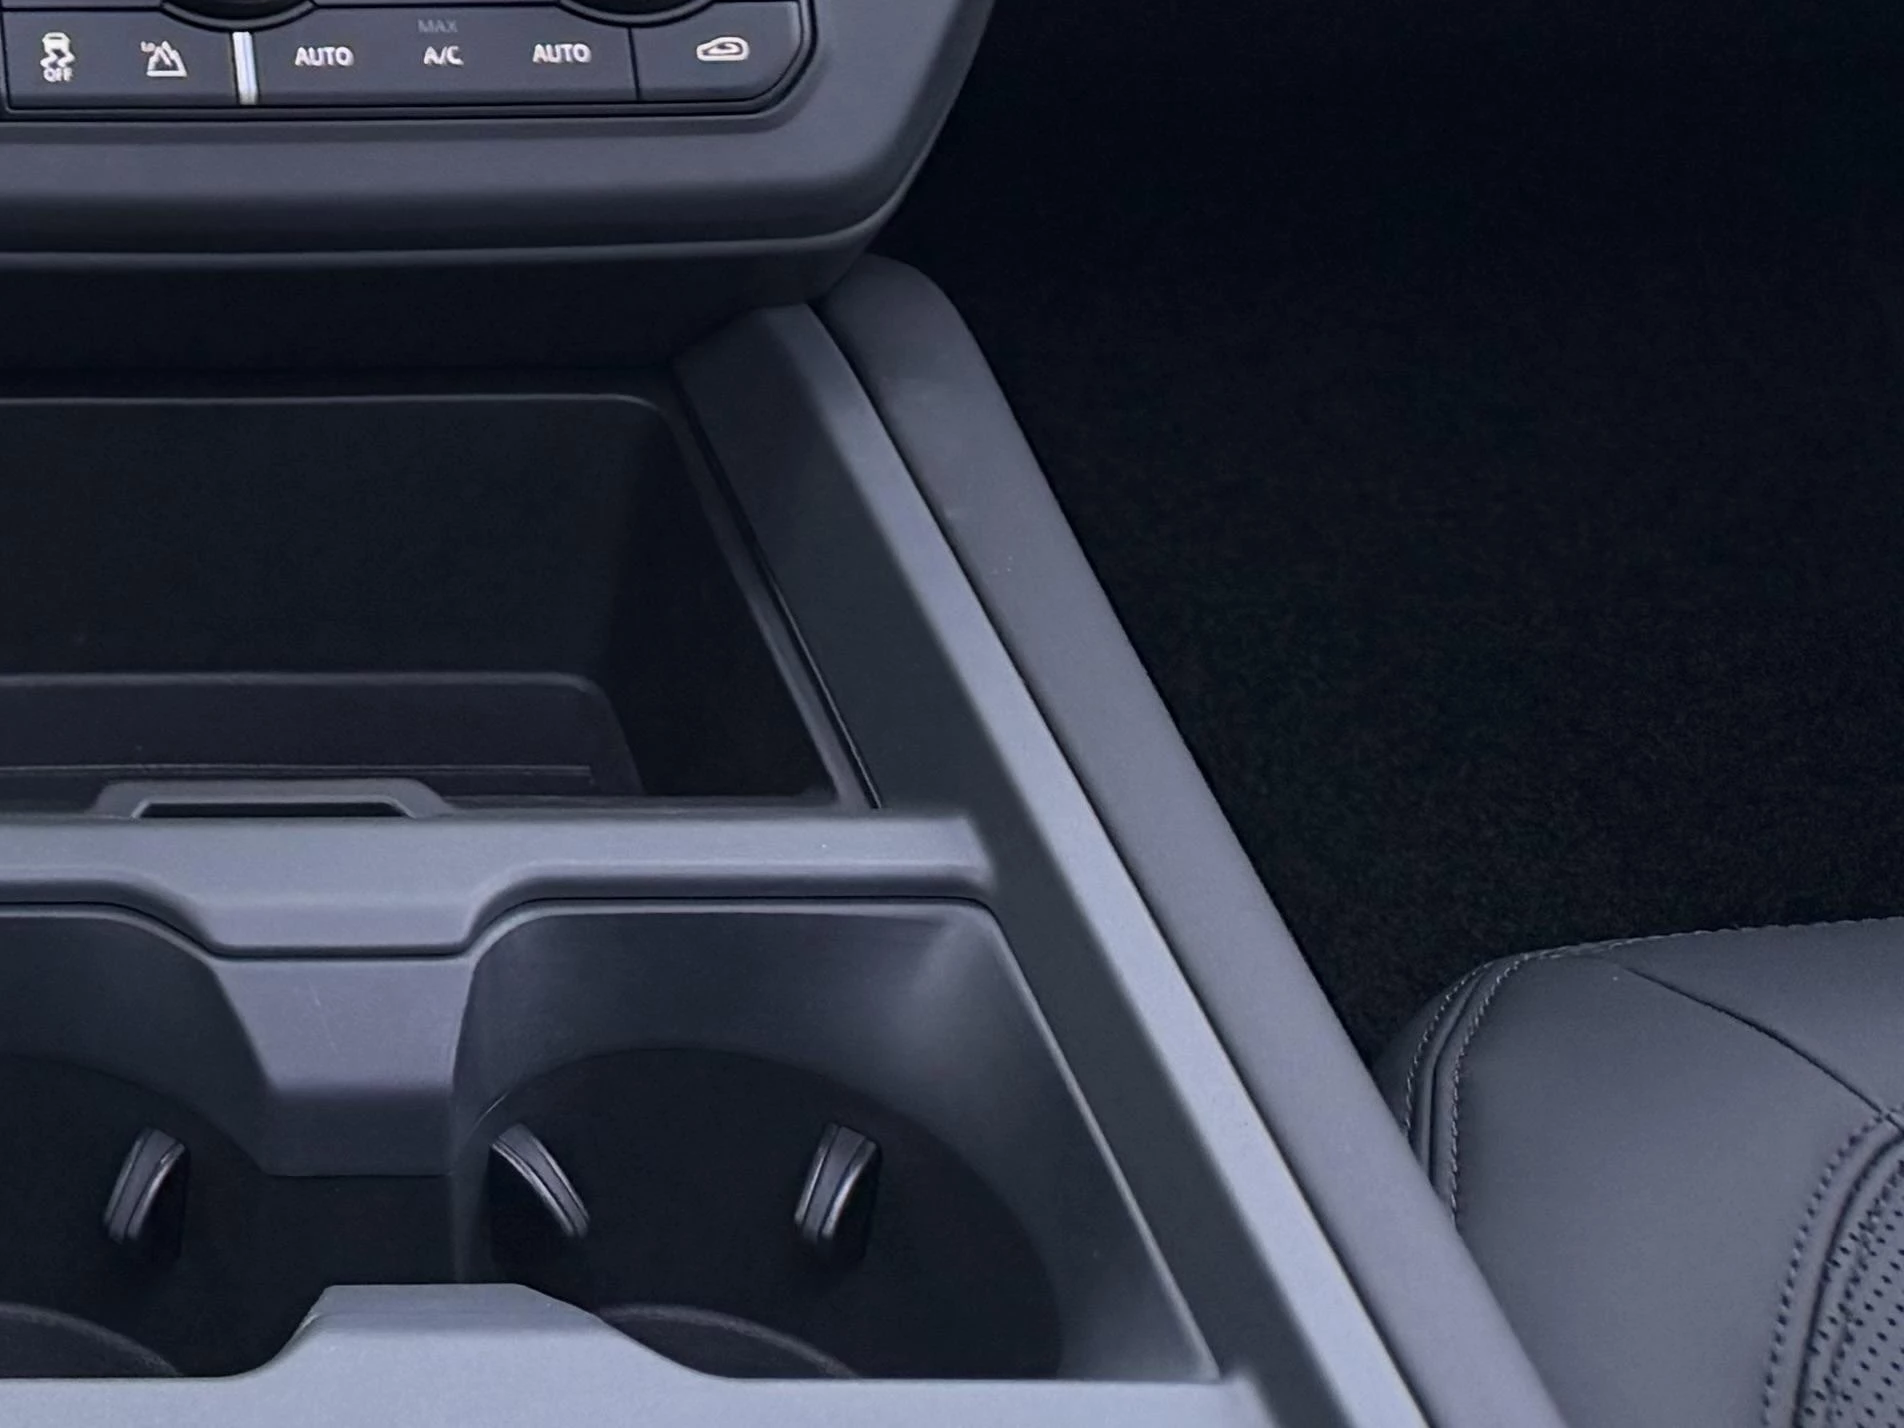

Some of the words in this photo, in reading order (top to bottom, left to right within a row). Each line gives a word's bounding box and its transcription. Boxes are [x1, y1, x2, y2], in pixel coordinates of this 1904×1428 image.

[417, 19, 458, 33] MAX
[294, 46, 355, 67] AUTO
[424, 46, 464, 65] A/C
[532, 43, 592, 64] AUTO
[43, 67, 73, 83] OFF
